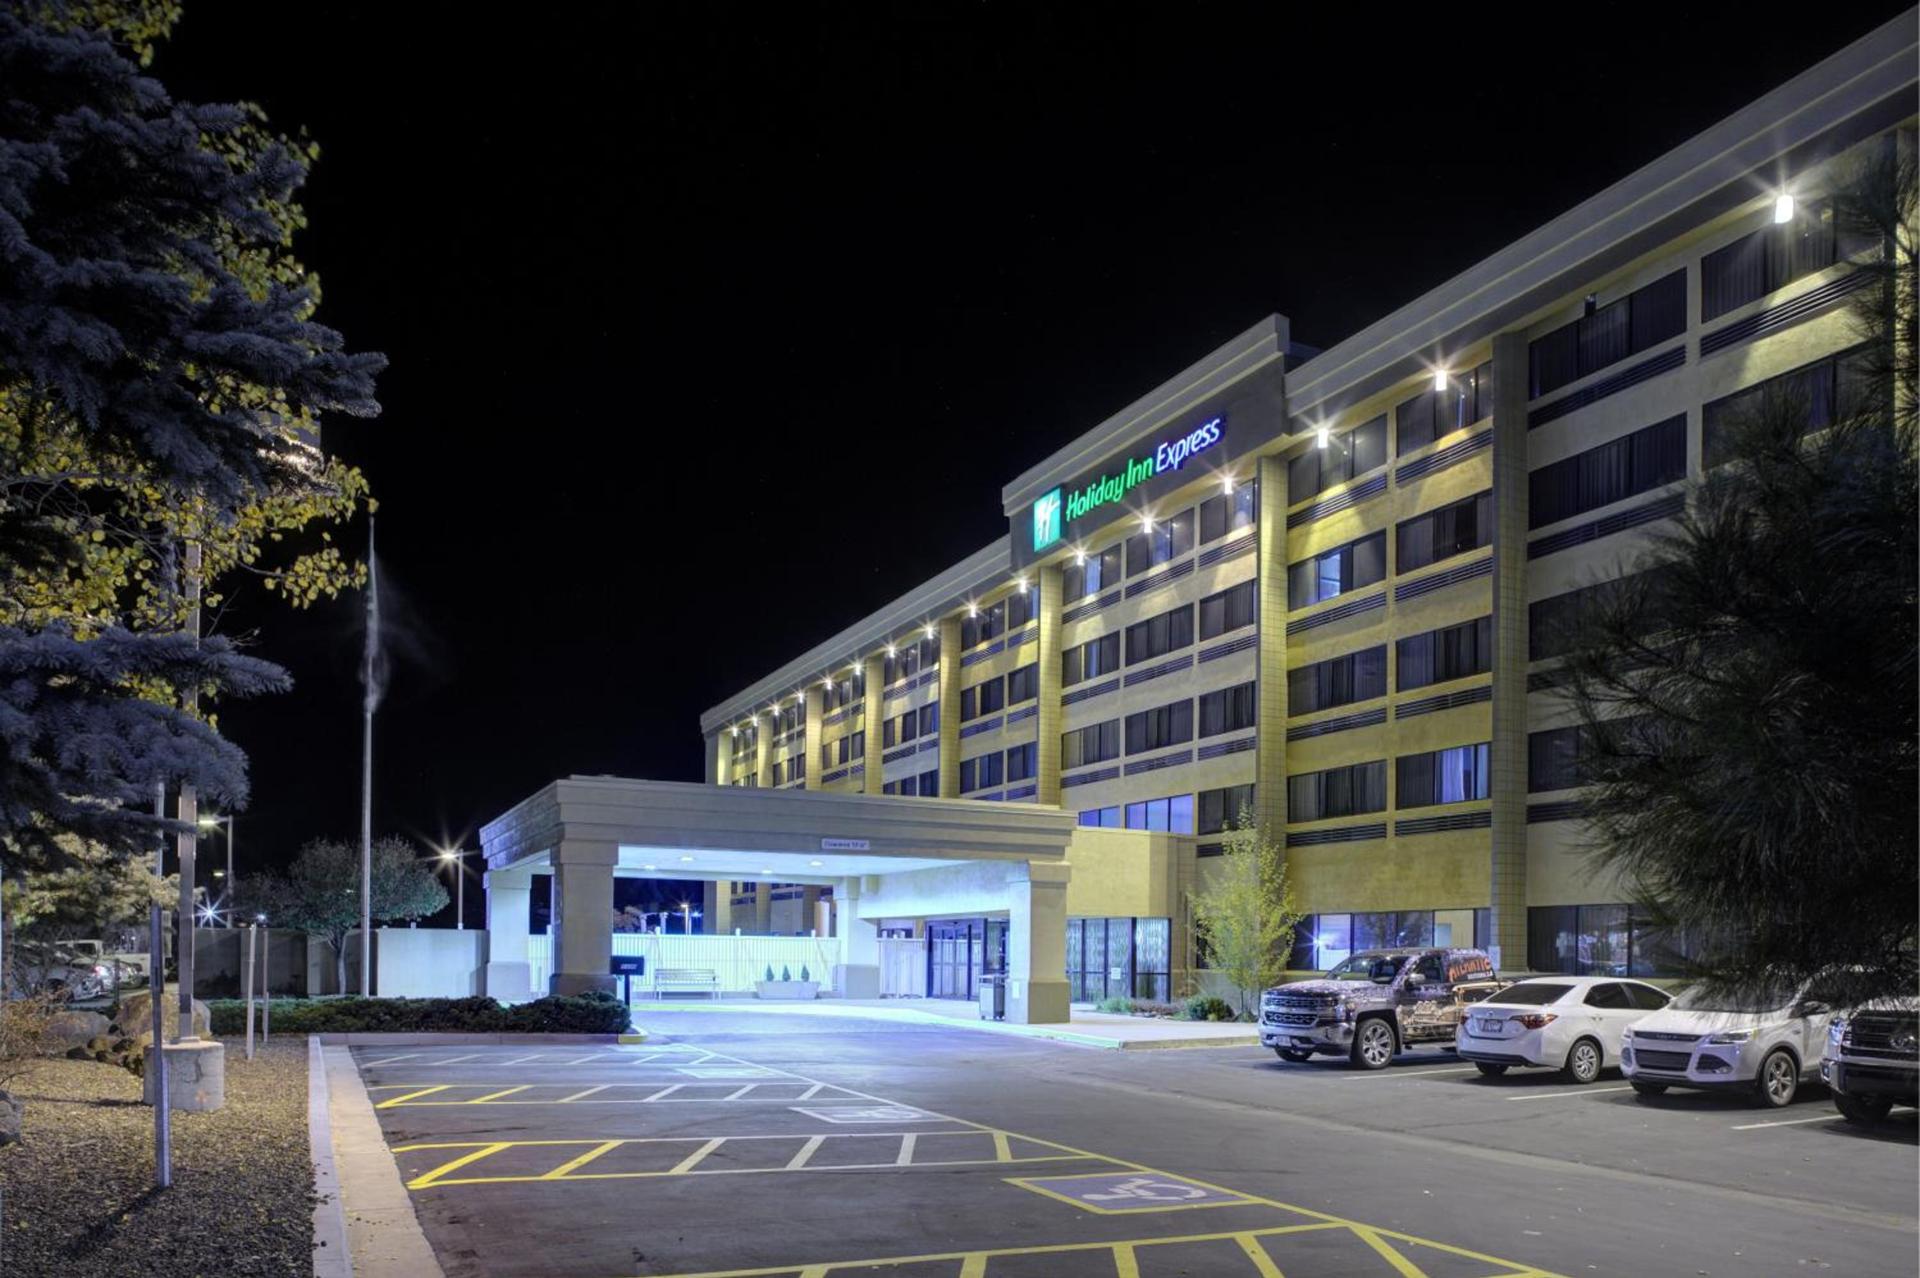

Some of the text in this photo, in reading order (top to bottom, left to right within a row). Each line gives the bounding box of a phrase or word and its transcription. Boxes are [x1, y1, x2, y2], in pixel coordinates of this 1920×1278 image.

[1065, 418, 1221, 522] Holiday Inn Express
